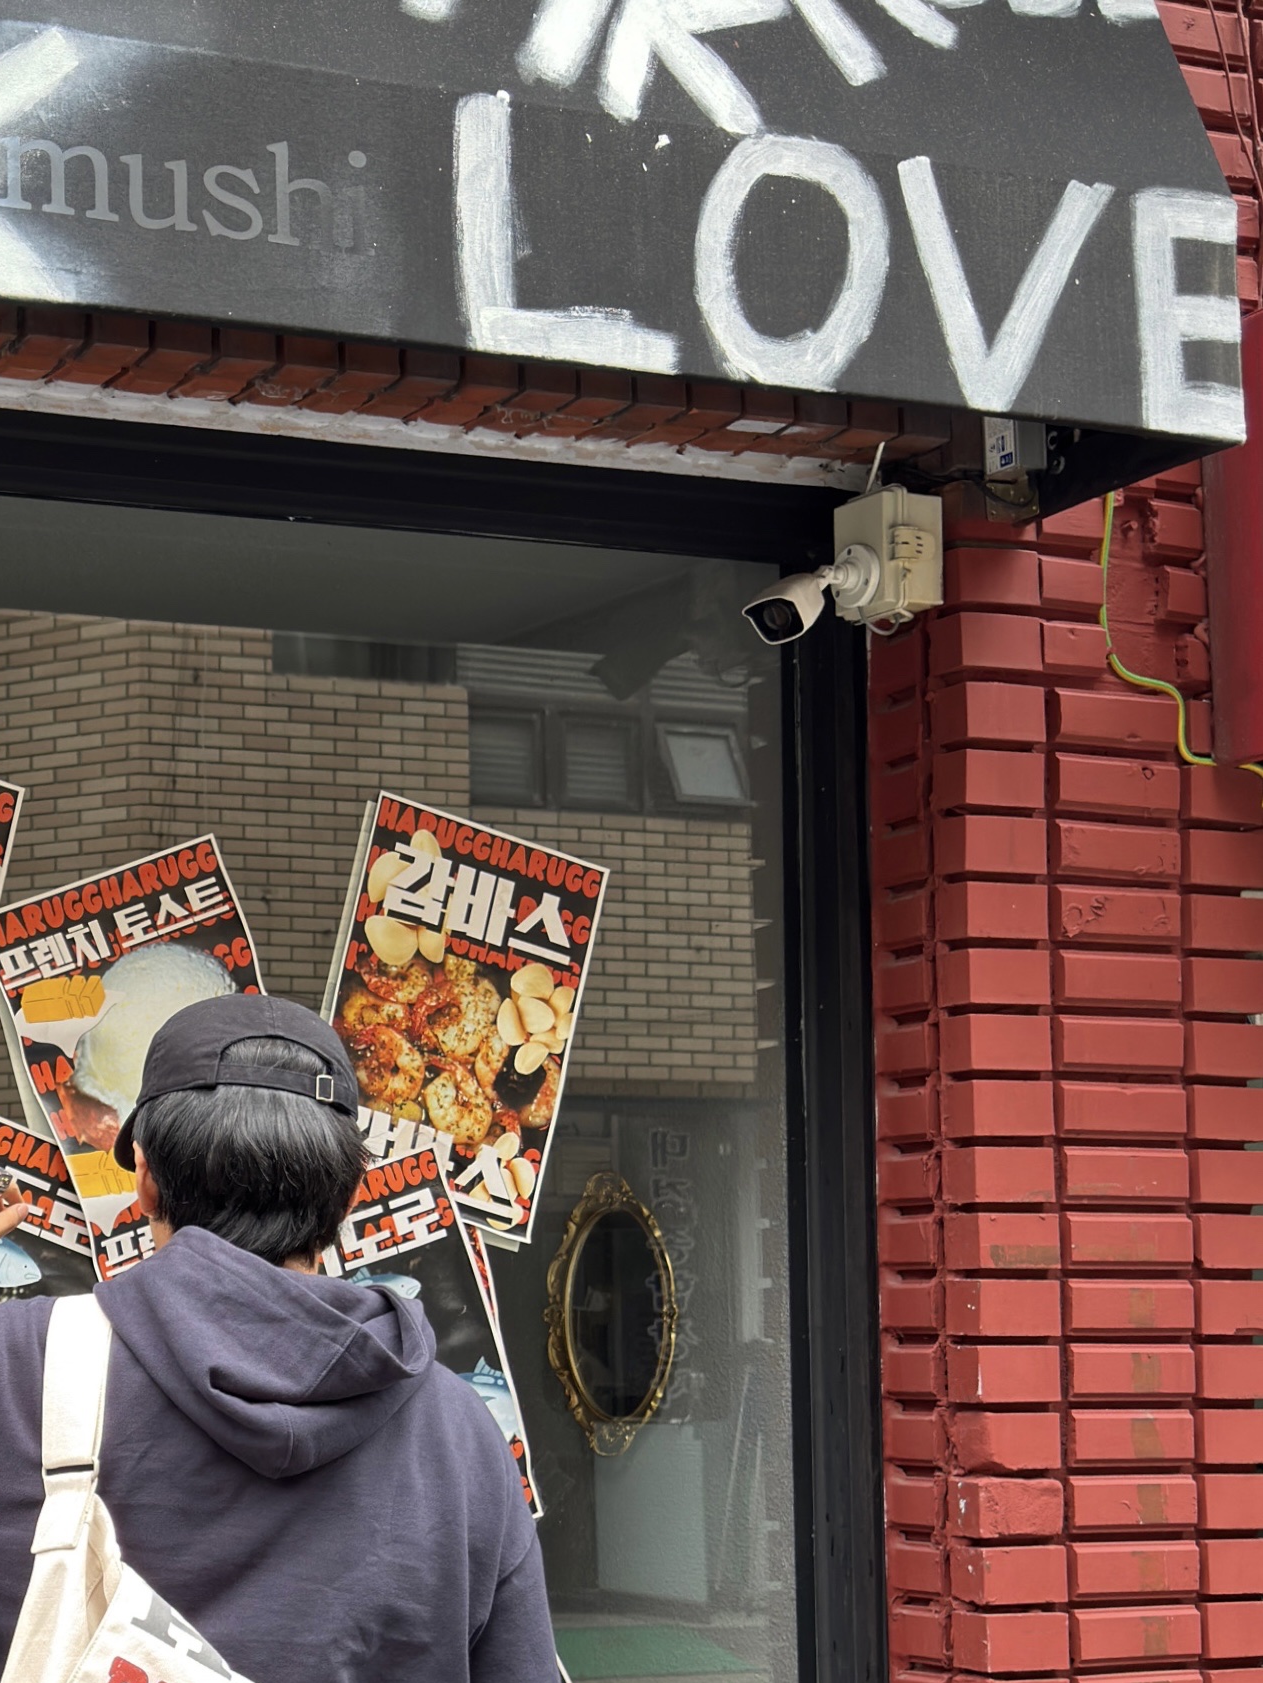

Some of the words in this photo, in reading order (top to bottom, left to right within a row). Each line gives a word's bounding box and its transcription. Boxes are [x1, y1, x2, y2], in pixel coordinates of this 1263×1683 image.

[452, 90, 1246, 443] LOVE
[114, 876, 231, 949] 토스트
[382, 842, 571, 966] 감바스
